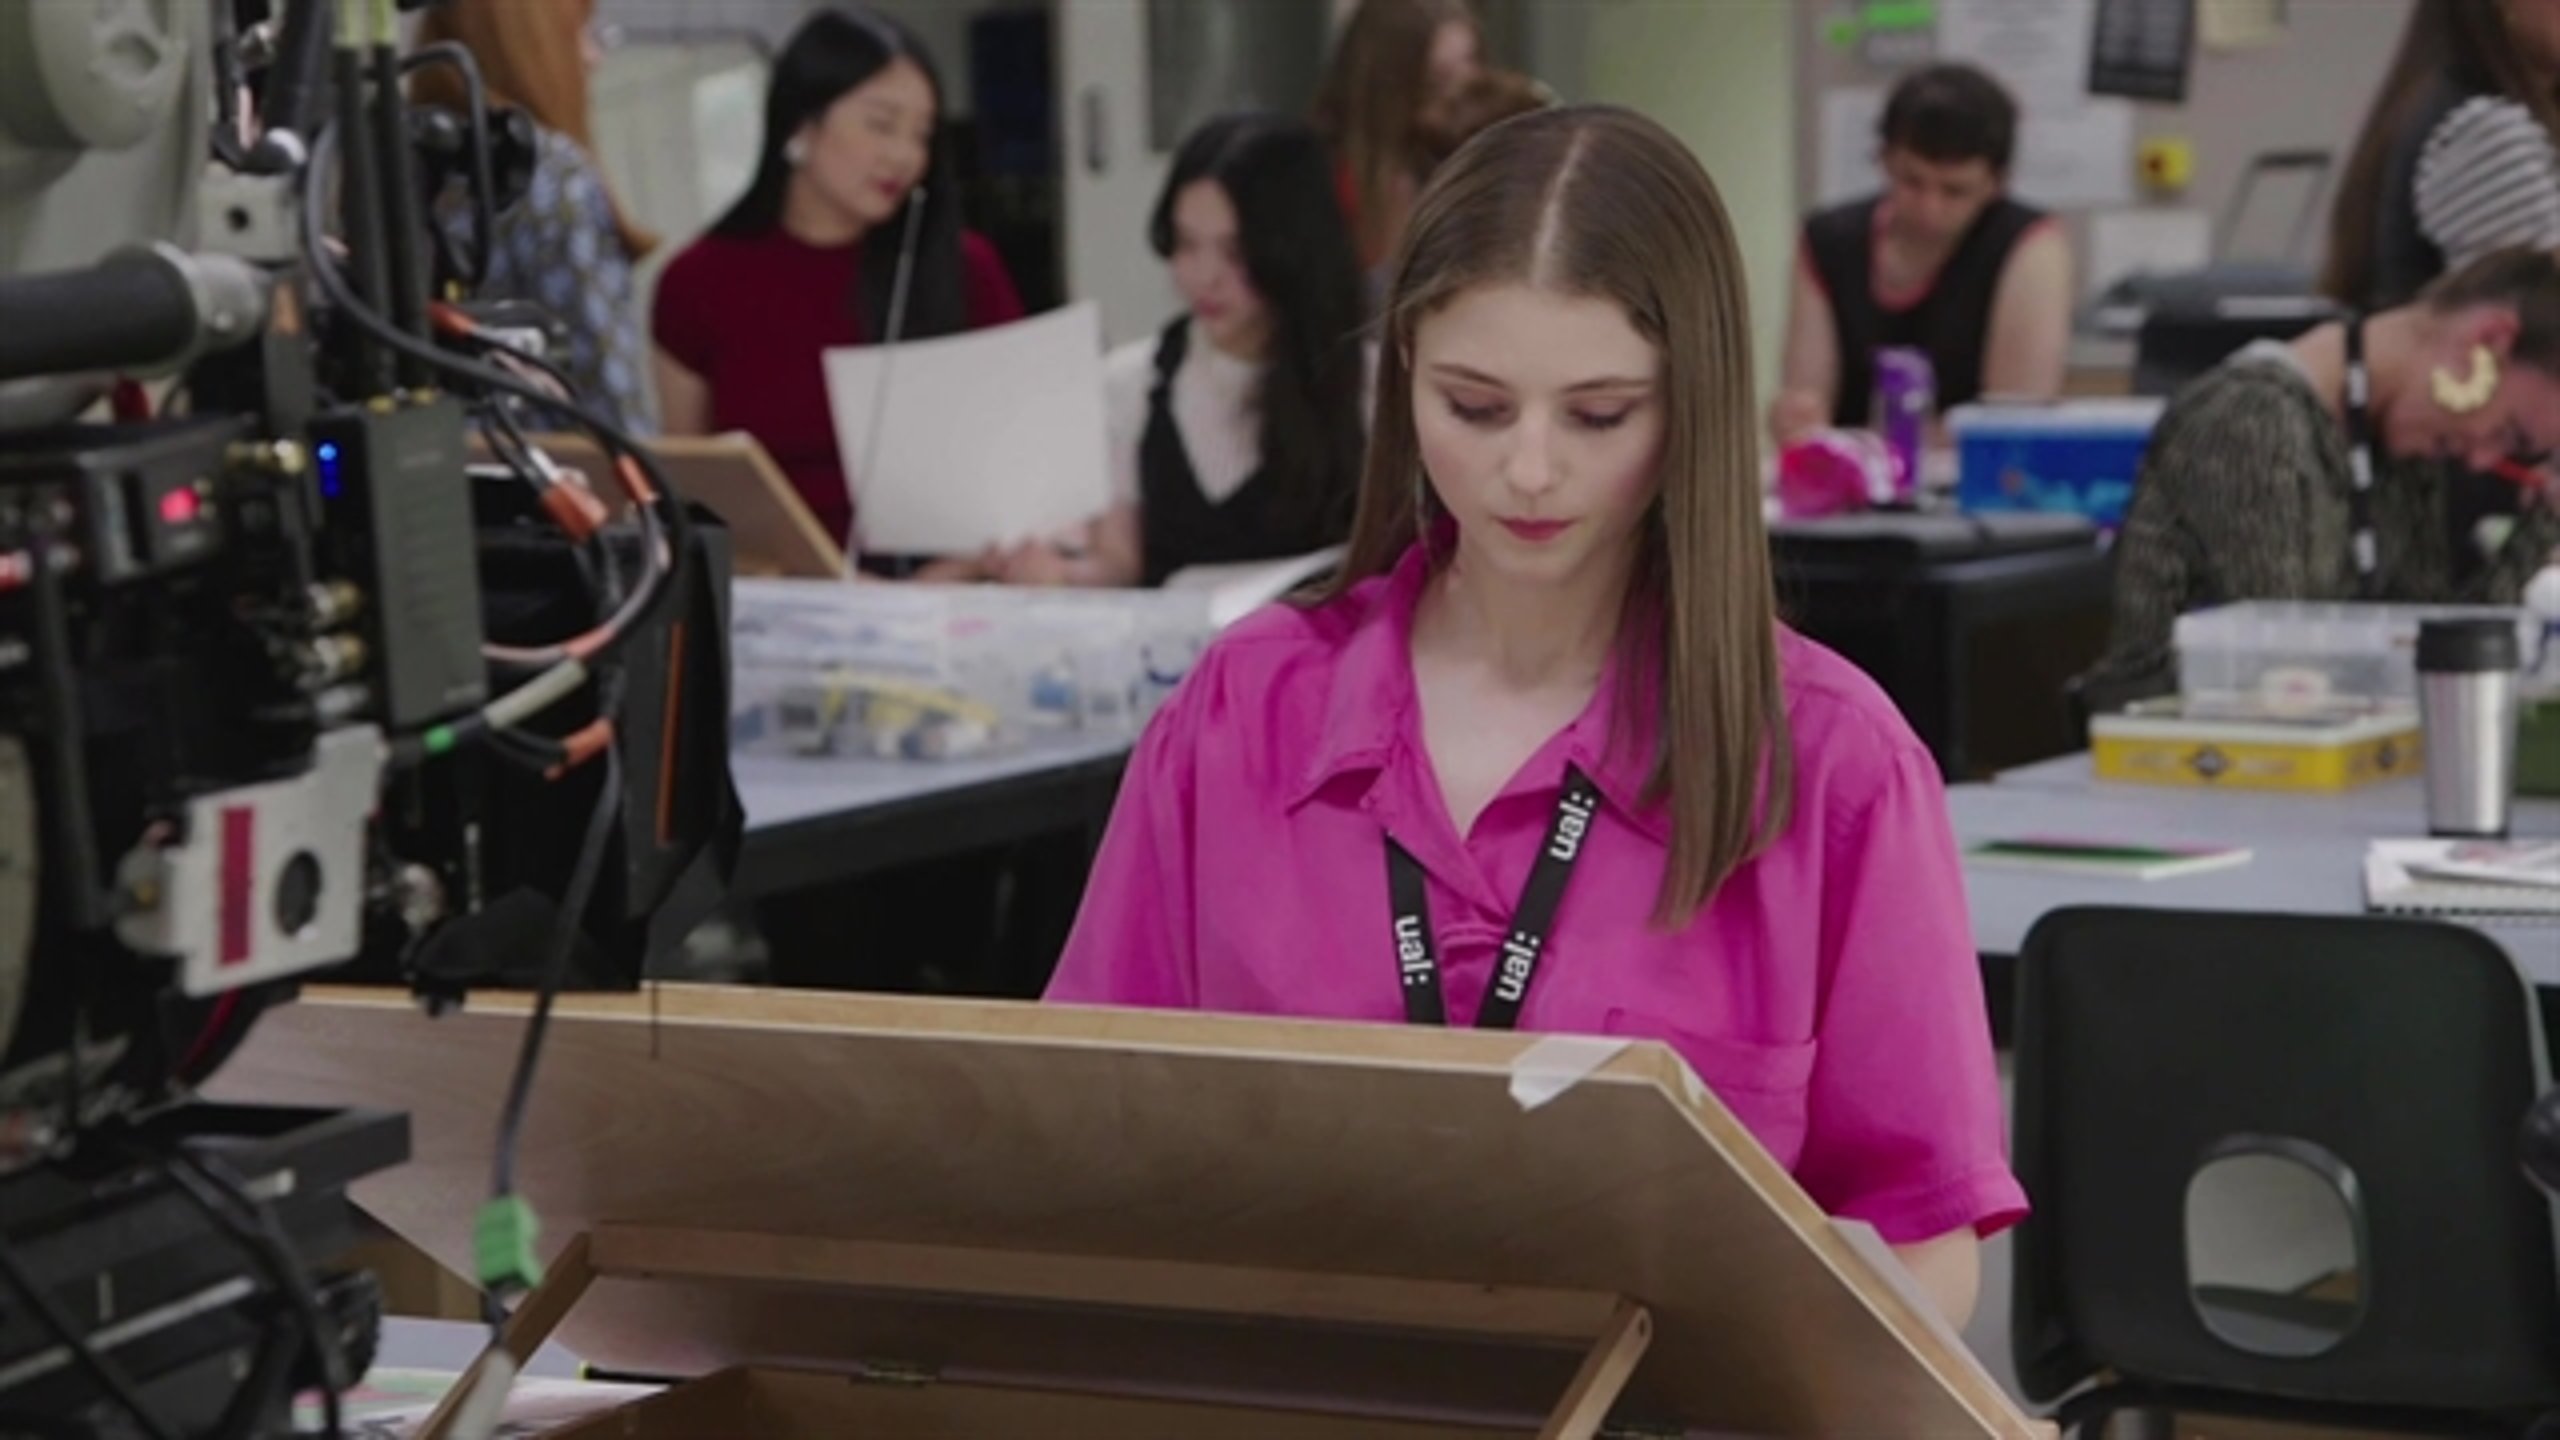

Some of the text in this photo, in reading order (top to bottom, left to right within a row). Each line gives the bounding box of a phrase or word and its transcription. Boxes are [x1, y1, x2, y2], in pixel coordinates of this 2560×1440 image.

[1551, 792, 1595, 861] ual:
[1395, 916, 1434, 985] ual:
[1496, 932, 1540, 1001] ual:
